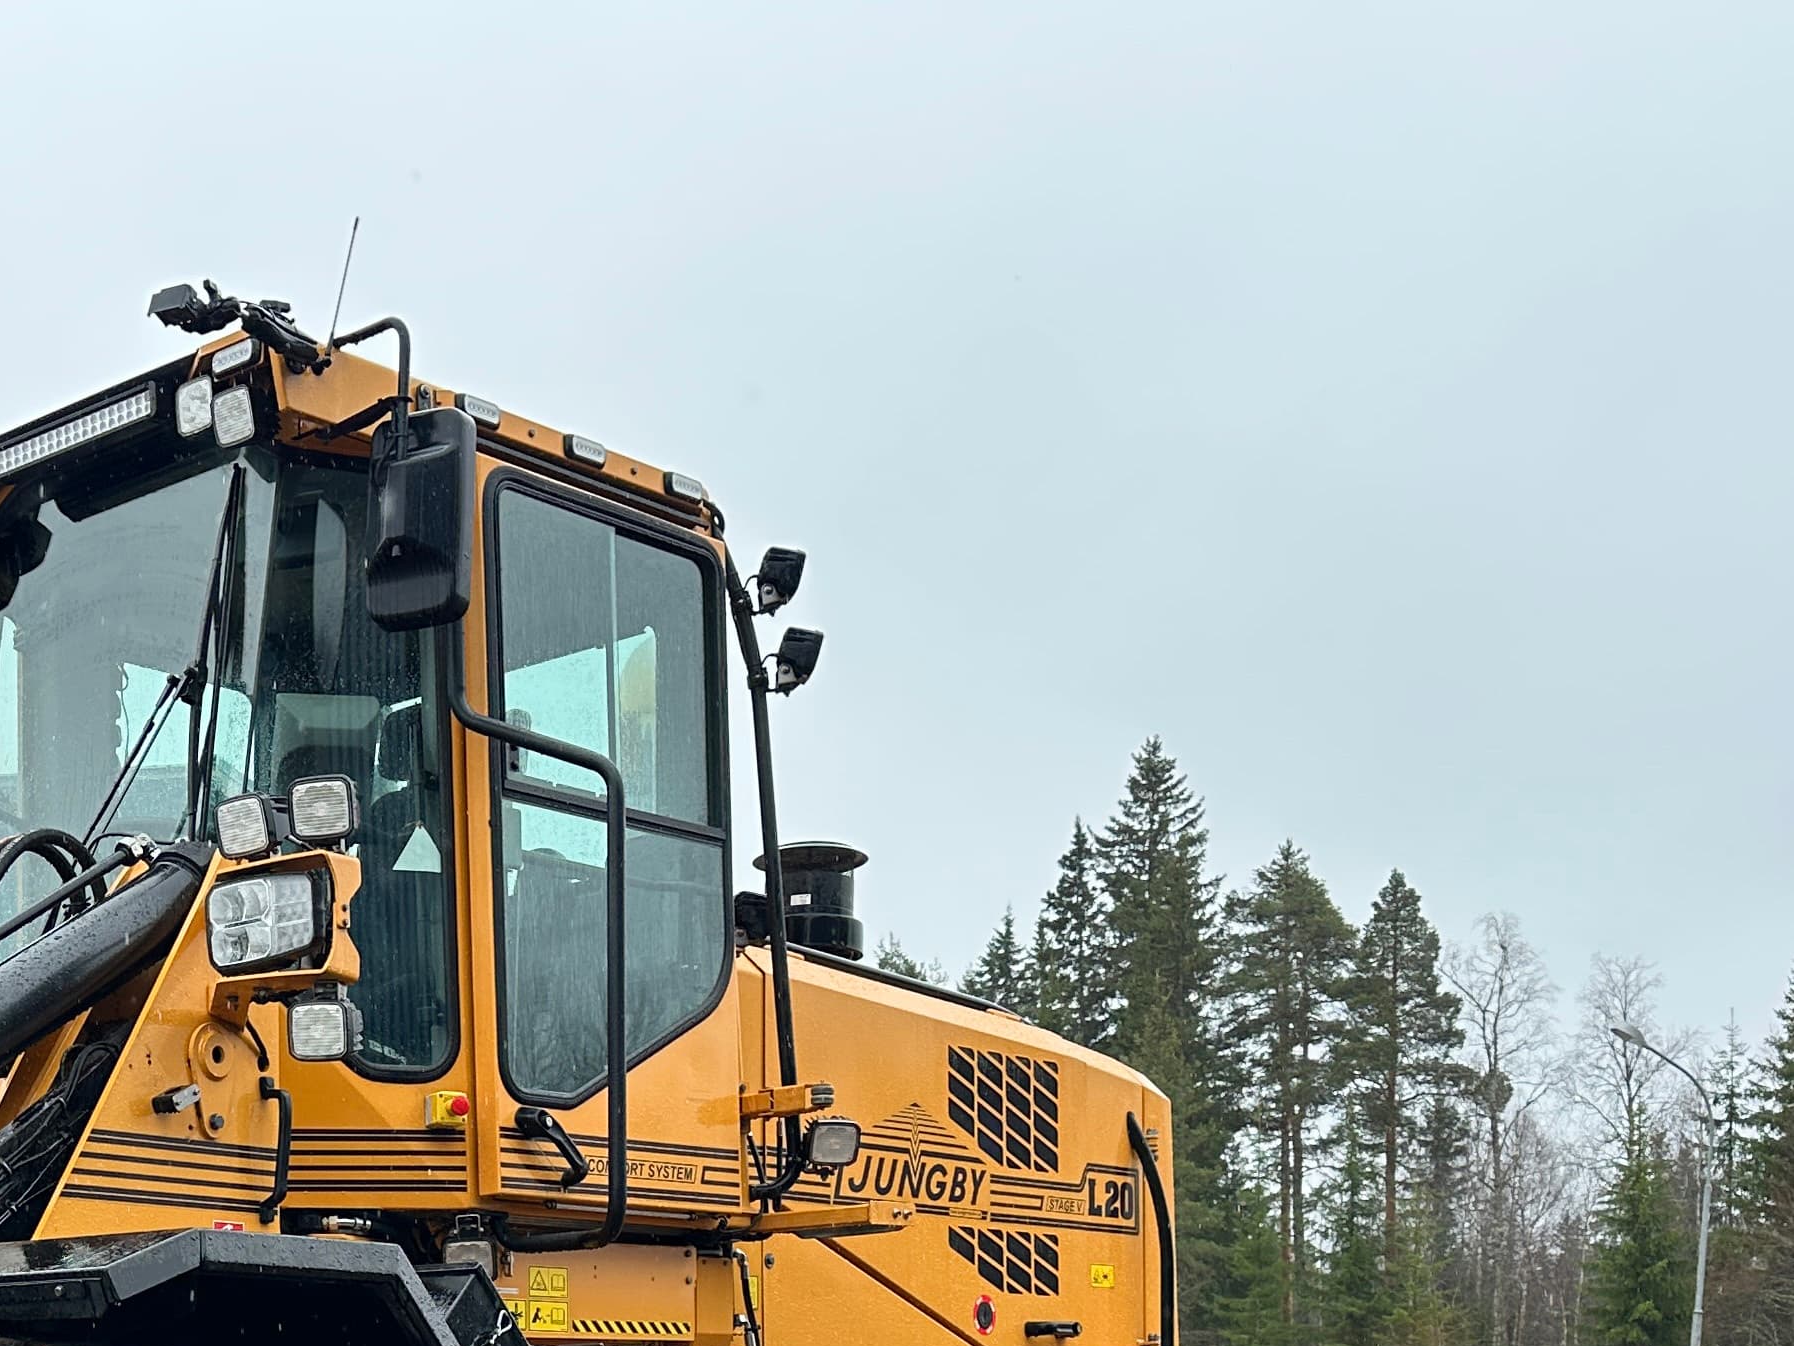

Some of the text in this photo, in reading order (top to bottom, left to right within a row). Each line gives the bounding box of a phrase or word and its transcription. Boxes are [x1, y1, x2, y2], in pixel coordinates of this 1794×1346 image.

[588, 1158, 693, 1180] CORT SYSTEM
[1049, 1199, 1083, 1212] STAGE V
[1088, 1178, 1134, 1220] L20
